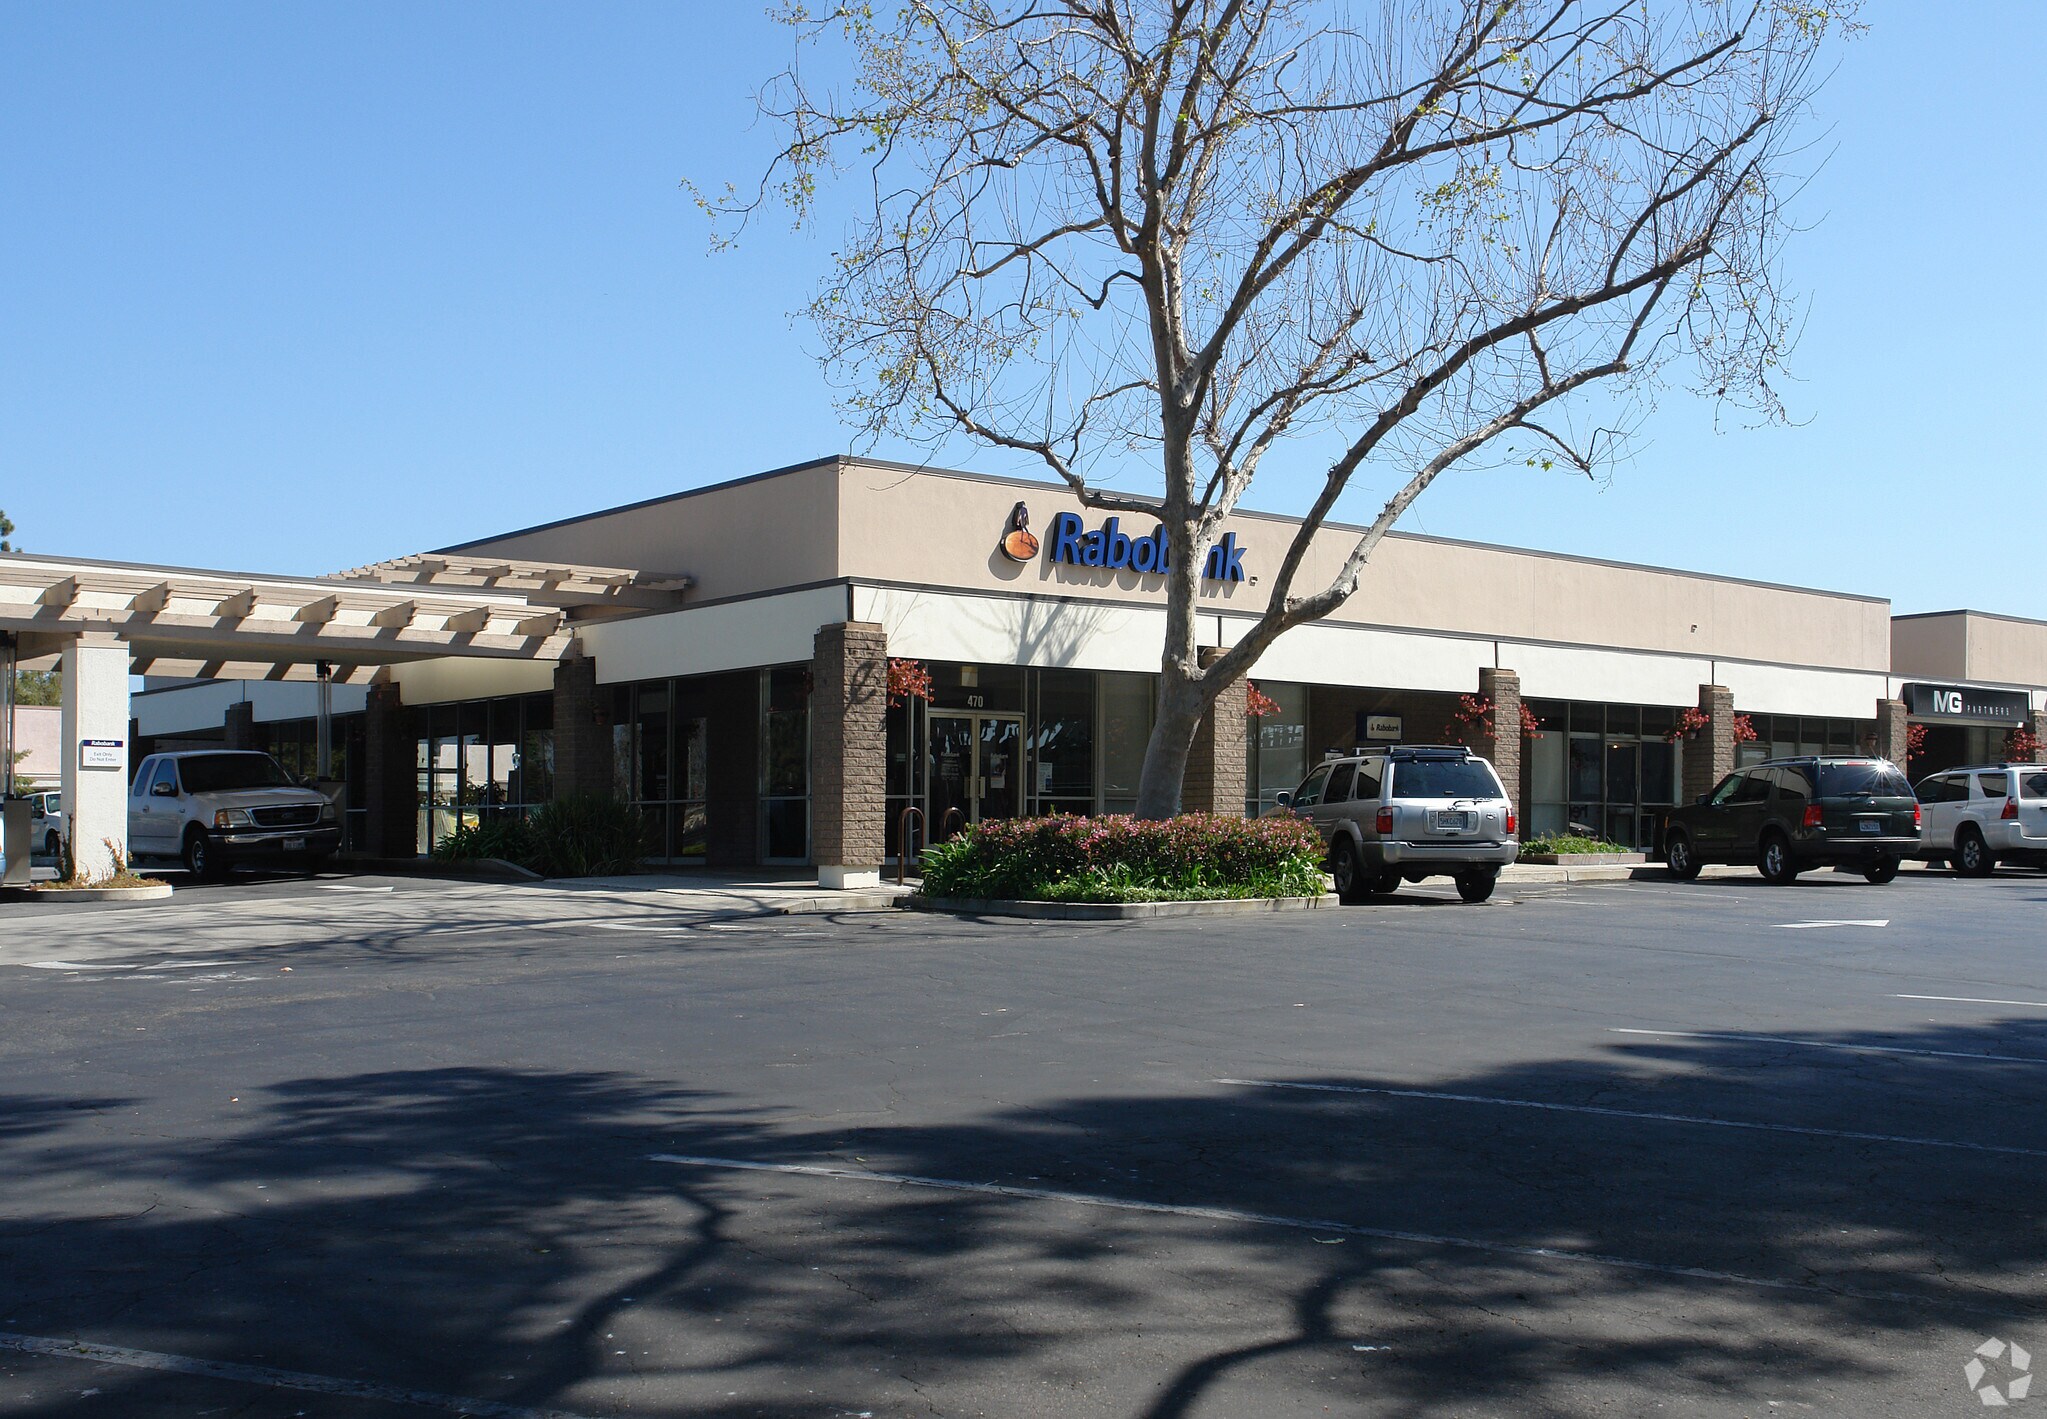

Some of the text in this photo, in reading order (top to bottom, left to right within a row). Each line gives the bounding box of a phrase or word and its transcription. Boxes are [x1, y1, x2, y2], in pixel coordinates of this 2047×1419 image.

[1050, 511, 1247, 582] Rabobnk
[967, 694, 984, 708] 470
[1933, 690, 1963, 714] MG
